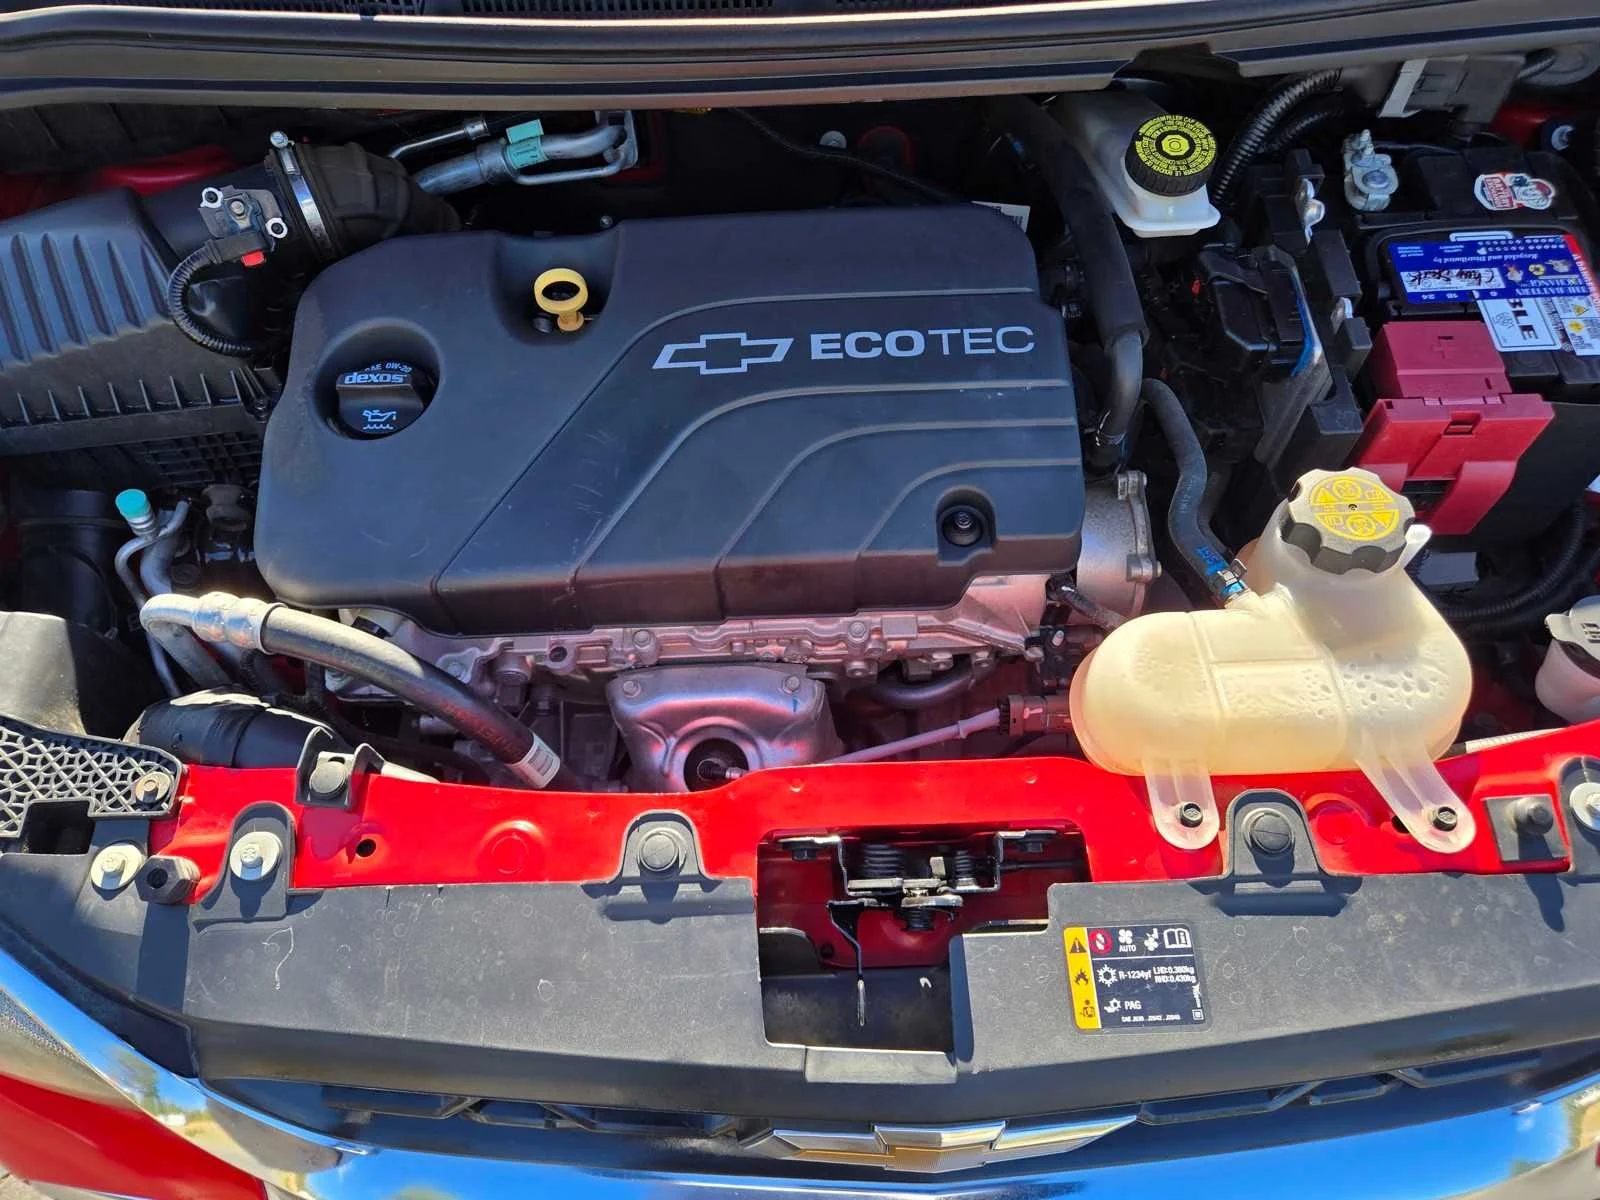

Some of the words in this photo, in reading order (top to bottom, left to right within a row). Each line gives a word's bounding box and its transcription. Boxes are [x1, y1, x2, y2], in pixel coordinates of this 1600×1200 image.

[1432, 256, 1443, 264] by
[1444, 255, 1486, 264] Distributed
[1504, 252, 1538, 261] Recycled
[1514, 286, 1563, 296] BATTERY
[1564, 285, 1587, 294] THE
[811, 325, 1036, 361] ECOTEC
[344, 372, 404, 384] dexos
[1118, 944, 1137, 952] AUTO
[1118, 970, 1152, 980] R-1234yf
[1124, 1000, 1142, 1010] PAG
